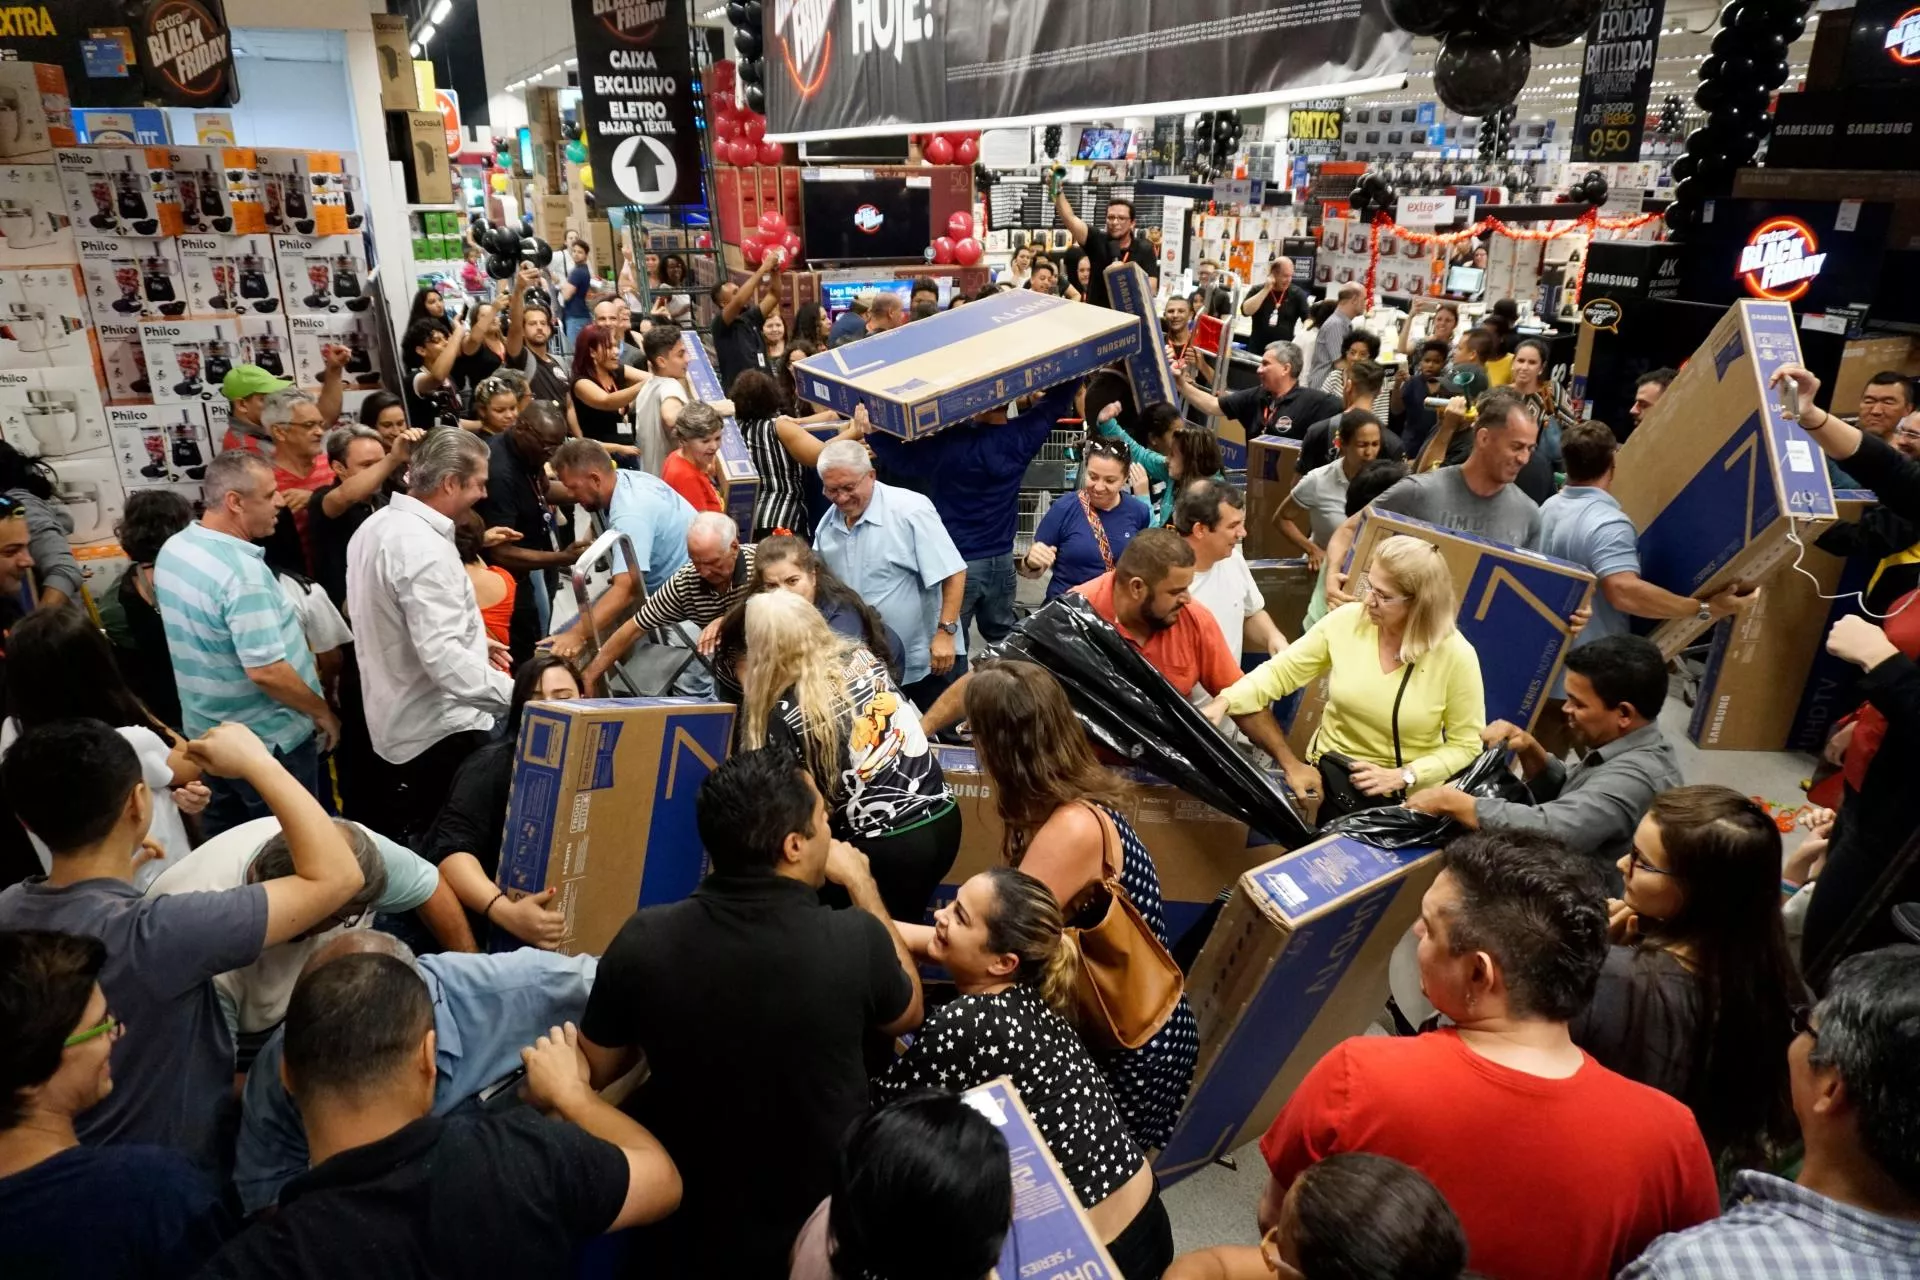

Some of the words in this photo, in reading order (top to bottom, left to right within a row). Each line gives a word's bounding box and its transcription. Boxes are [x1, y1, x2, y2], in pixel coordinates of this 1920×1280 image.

[155, 12, 184, 32] extra
[616, 2, 667, 31] FRIDAY
[1598, 8, 1654, 40] FRIDAY
[376, 22, 404, 31] Consul
[147, 19, 205, 68] BLACK
[175, 34, 228, 85] FRIDAY
[609, 50, 657, 69] CAIXA
[1585, 40, 1653, 75] BATEDEIRA
[594, 76, 676, 95] EXCLUSIVO
[609, 101, 667, 119] ELETRO
[413, 118, 441, 127] Consul
[599, 121, 634, 135] BAZAR
[636, 124, 642, 132] e
[644, 118, 676, 133] TÊXTIL
[1289, 110, 1341, 138] GRATIS
[1775, 124, 1835, 136] SAMSUNG
[1847, 122, 1913, 135] SAMSUNG
[58, 152, 93, 165] Philco
[1407, 200, 1434, 213] extra
[81, 240, 118, 252] Philco
[181, 239, 216, 249] Philco
[279, 239, 312, 249] Philco
[1739, 237, 1806, 273] BLACK
[1658, 259, 1679, 277] 4K
[1760, 253, 1827, 290] FRIDAY
[1586, 272, 1639, 288] SAMSUNG
[1117, 274, 1134, 313] SAMSU
[293, 318, 325, 329] Philco
[1751, 313, 1788, 322] SAMSUNG
[101, 325, 137, 335] Philco
[144, 325, 180, 337] Philco
[1096, 333, 1137, 356] SAMSUNG
[111, 411, 148, 422] Philco
[212, 405, 231, 417] Phi
[1522, 679, 1542, 711] SERIES
[1707, 695, 1731, 744] SAMSUNG
[571, 795, 583, 832] FRONT
[1020, 1251, 1066, 1278] SERIES
